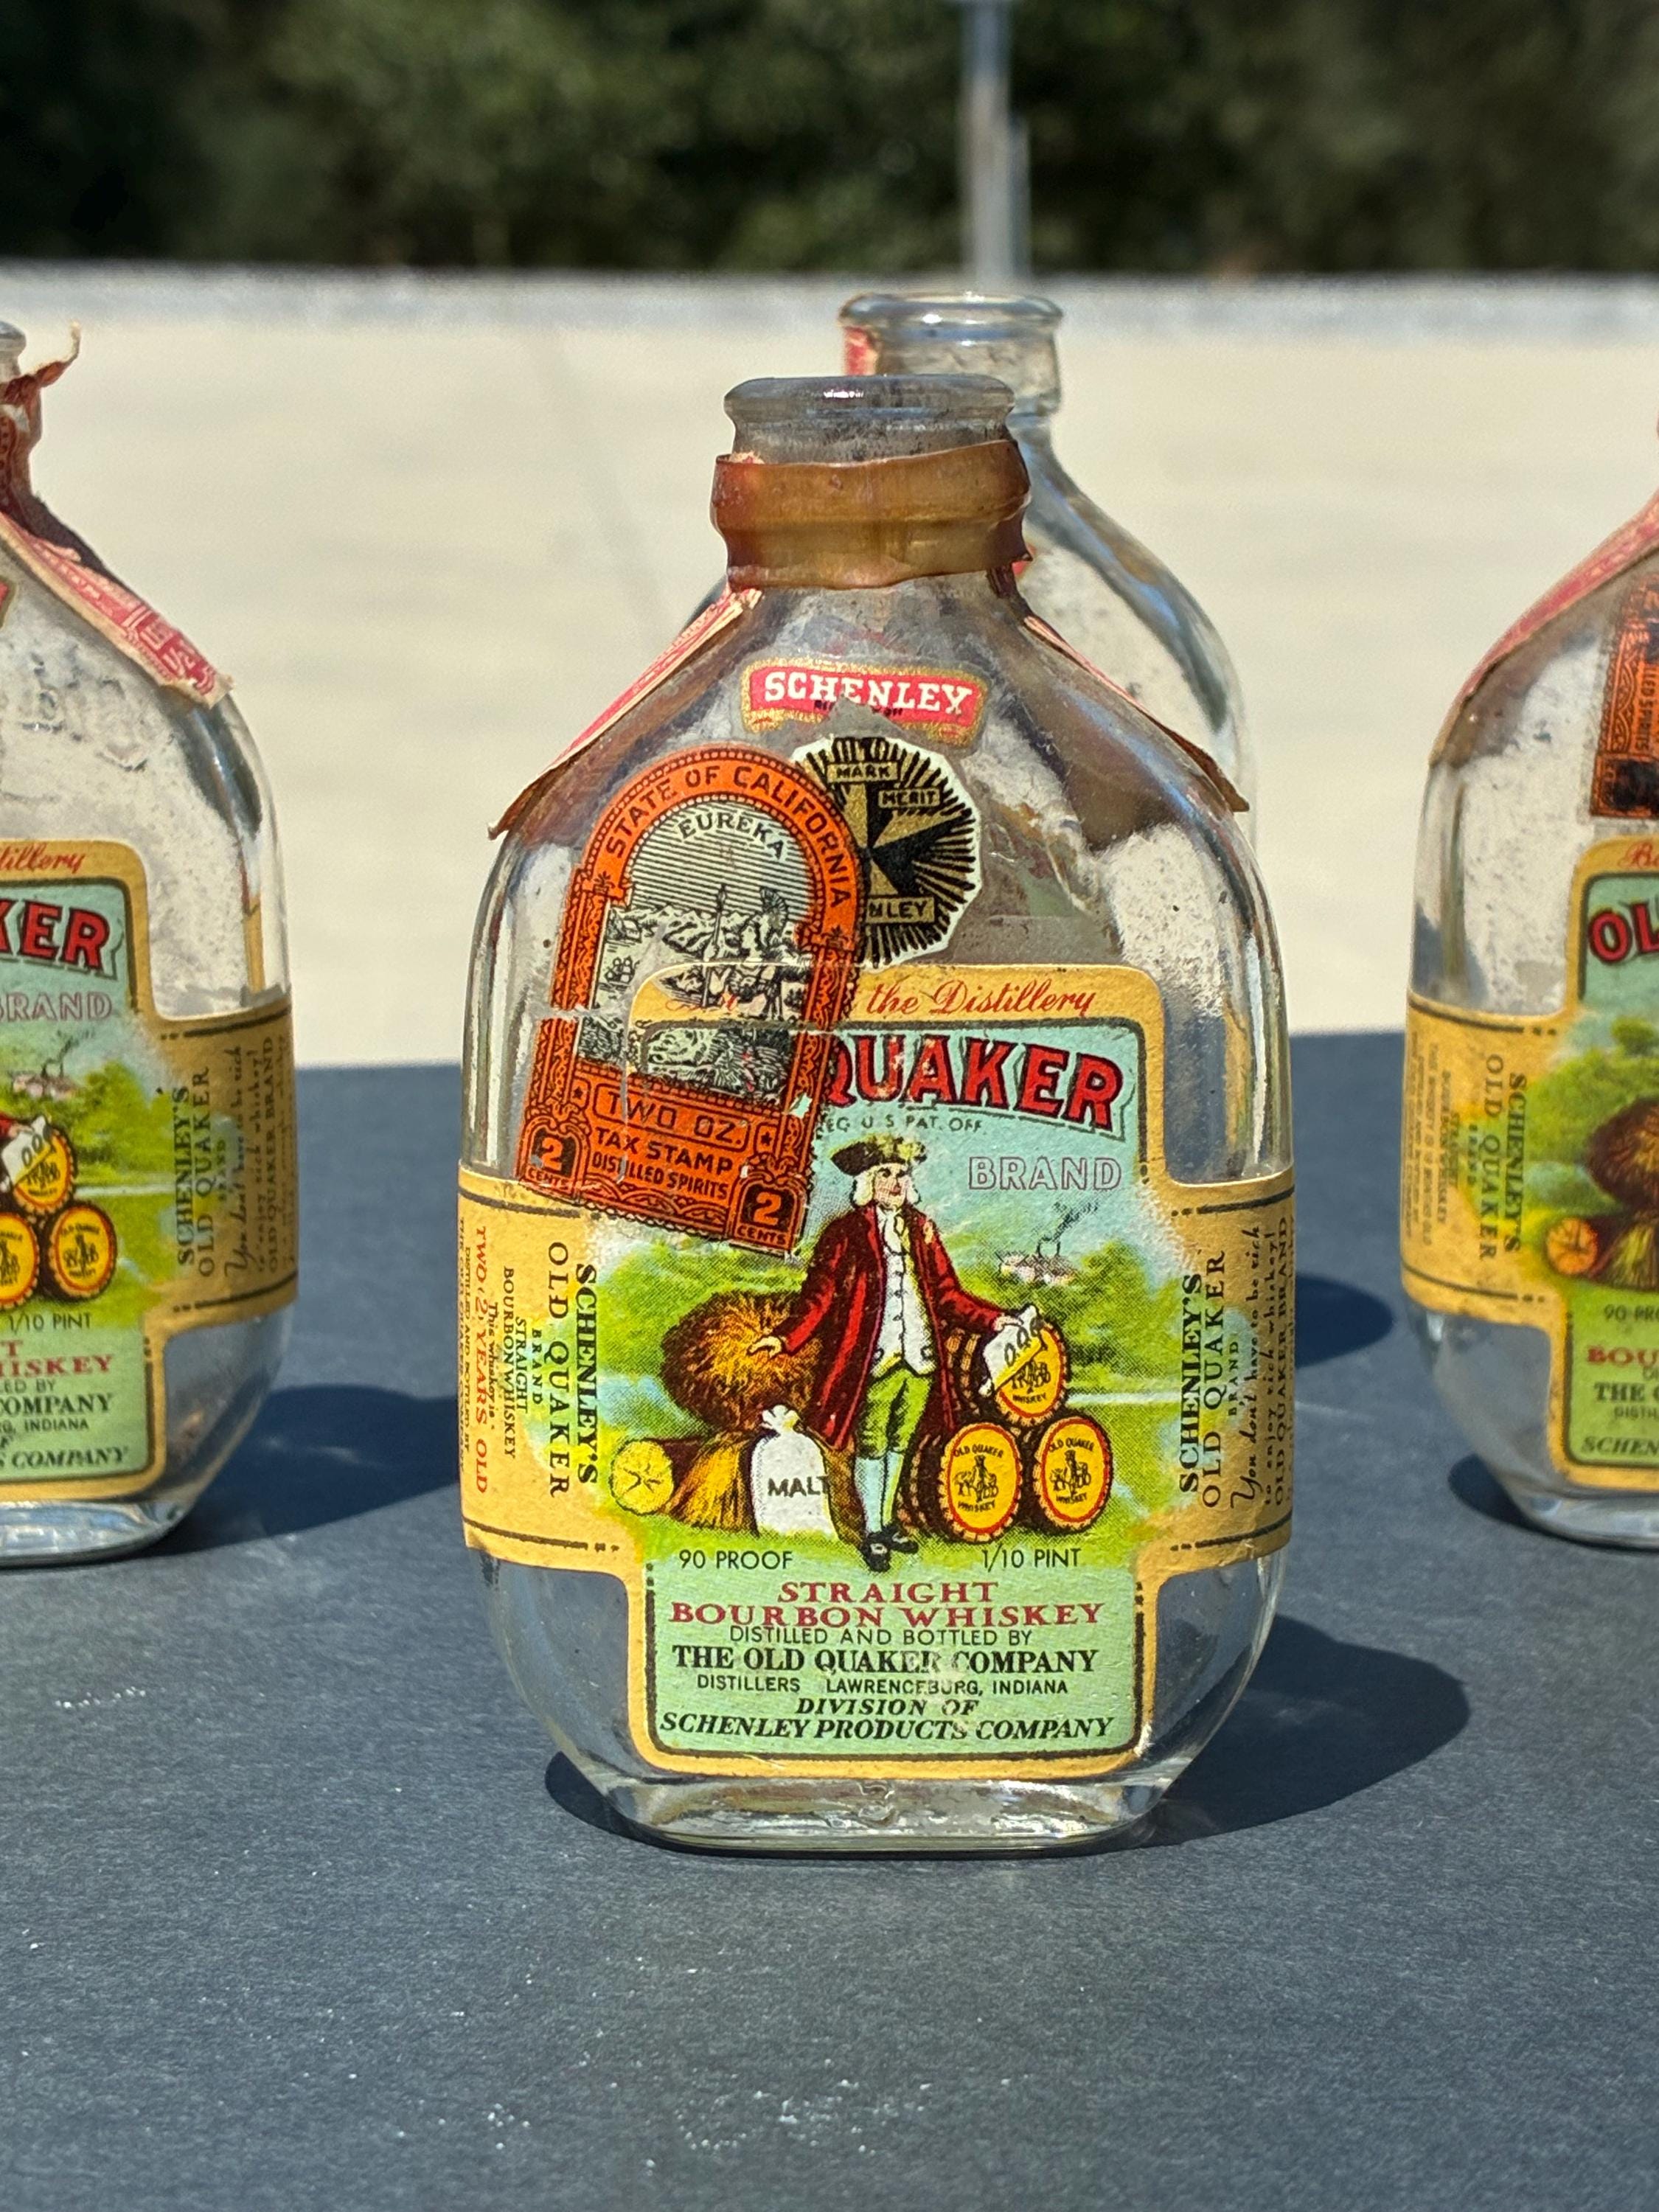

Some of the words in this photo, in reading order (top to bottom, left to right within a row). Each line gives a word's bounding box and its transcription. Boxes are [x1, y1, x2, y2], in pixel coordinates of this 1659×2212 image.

[764, 672, 973, 714] SCHENLEY
[836, 764, 891, 779] MARK
[883, 790, 936, 805] MERIT
[606, 779, 678, 860] STATE
[684, 764, 720, 790] OF
[733, 765, 853, 908] CALIFORNIA
[678, 813, 785, 860] EUREKA
[0, 990, 112, 1022] RAND
[865, 983, 921, 1015] the
[930, 978, 1097, 1017] Distillery
[262, 1037, 275, 1119] BRAND
[1486, 1054, 1503, 1119] OLD
[192, 1067, 216, 1197] QUAKER
[606, 1091, 677, 1127] TWO
[694, 1115, 743, 1147] OZ.
[172, 1085, 194, 1265] SCHENLEY'S
[267, 1128, 279, 1221] QUAKER
[541, 1135, 564, 1172] 2
[594, 1126, 639, 1155] TAX
[646, 1141, 734, 1177] STAMP
[968, 1156, 1122, 1191] BRAND
[1504, 1072, 1526, 1253] SCHENLEY'S
[591, 1151, 664, 1187] DISILLED
[666, 1171, 728, 1202] SPIRITS
[1478, 1135, 1500, 1261] QUAKER
[755, 1190, 782, 1225] 2
[197, 1214, 215, 1277] OLD
[268, 1227, 278, 1273] OLD
[476, 1226, 486, 1283] TWO
[738, 1224, 788, 1246] CENTS
[1242, 1225, 1260, 1269] rich
[548, 1241, 570, 1320] OLD
[1245, 1279, 1259, 1301] be
[1279, 1217, 1287, 1318] BRAND
[52, 1312, 91, 1330] PINT
[488, 1302, 498, 1336] This
[503, 1266, 514, 1363] BOURBON
[1203, 1251, 1227, 1411] QUAKER
[1249, 1310, 1259, 1328] to
[1604, 1304, 1627, 1322] 90
[476, 1329, 487, 1425] YEARS
[515, 1316, 528, 1413] STRAIGHT
[532, 1328, 543, 1405] BRAND
[575, 1263, 598, 1485] SCHENLEY'S
[1228, 1342, 1239, 1416] BRAND
[1243, 1337, 1259, 1380] have
[1259, 1349, 1274, 1395] rich
[1179, 1273, 1201, 1493] SCHENLEY'S
[1276, 1329, 1287, 1442] QUAKER
[1594, 1382, 1646, 1402] THE
[24, 1418, 89, 1432] INDIANA
[504, 1371, 515, 1459] WHISKEY
[544, 1340, 570, 1499] QUAKER
[1240, 1394, 1258, 1444] don't
[1265, 1408, 1276, 1469] enjoy
[12, 1445, 129, 1469] COMPANY
[476, 1439, 487, 1494] OLD
[972, 1444, 1004, 1458] QUAKER
[1202, 1431, 1222, 1509] OLD
[767, 1475, 830, 1499] MALT
[1230, 1453, 1264, 1509] You
[1276, 1449, 1284, 1506] OLD
[678, 1551, 712, 1571] 90
[715, 1551, 794, 1571] PROOF
[980, 1549, 1027, 1575] 1/10
[1033, 1548, 1081, 1569] PINT
[668, 1601, 883, 1627] BOURBON
[901, 1602, 1105, 1628] WHISKEY
[777, 1582, 999, 1604] STRAIGHT
[729, 1625, 829, 1645] DISTILLED
[839, 1627, 891, 1646] AND
[902, 1630, 999, 1646] BOTTLED
[1007, 1630, 1033, 1646] BY
[672, 1645, 736, 1672] THE
[743, 1647, 805, 1671] OLD
[814, 1649, 945, 1674] QUAKER
[952, 1649, 1099, 1674] COMPANY
[697, 1674, 801, 1692] DISTILLERS
[825, 1677, 984, 1698] LAWRENCEBURG,
[992, 1678, 1068, 1695] INDIANA
[795, 1698, 926, 1716] DIVISION
[941, 1699, 980, 1716] OF
[660, 1712, 812, 1741] SCHENLEY
[814, 1717, 968, 1741] PRODUCTS
[975, 1717, 1115, 1741] COMPANY
